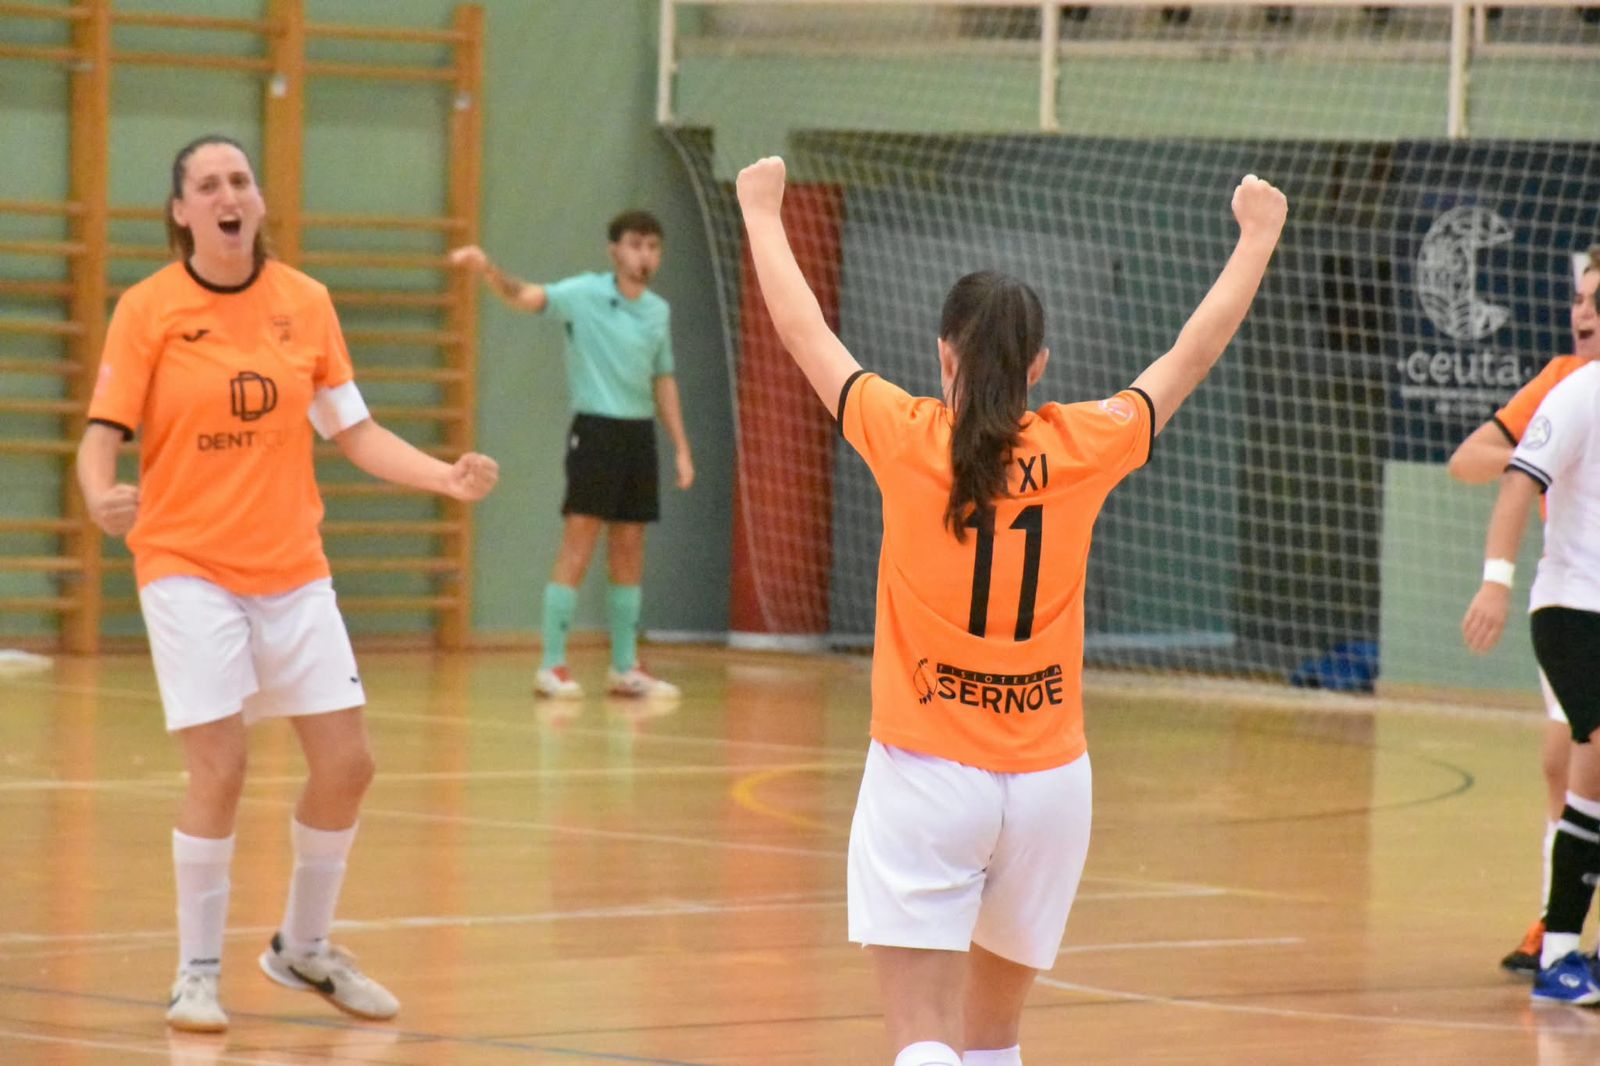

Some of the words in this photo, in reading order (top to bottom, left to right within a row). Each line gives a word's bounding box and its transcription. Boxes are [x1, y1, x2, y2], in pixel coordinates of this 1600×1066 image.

[1407, 351, 1521, 385] ceuta
[1017, 453, 1049, 493] XI
[963, 504, 1044, 642] 11
[937, 675, 1063, 714] SERNOE
